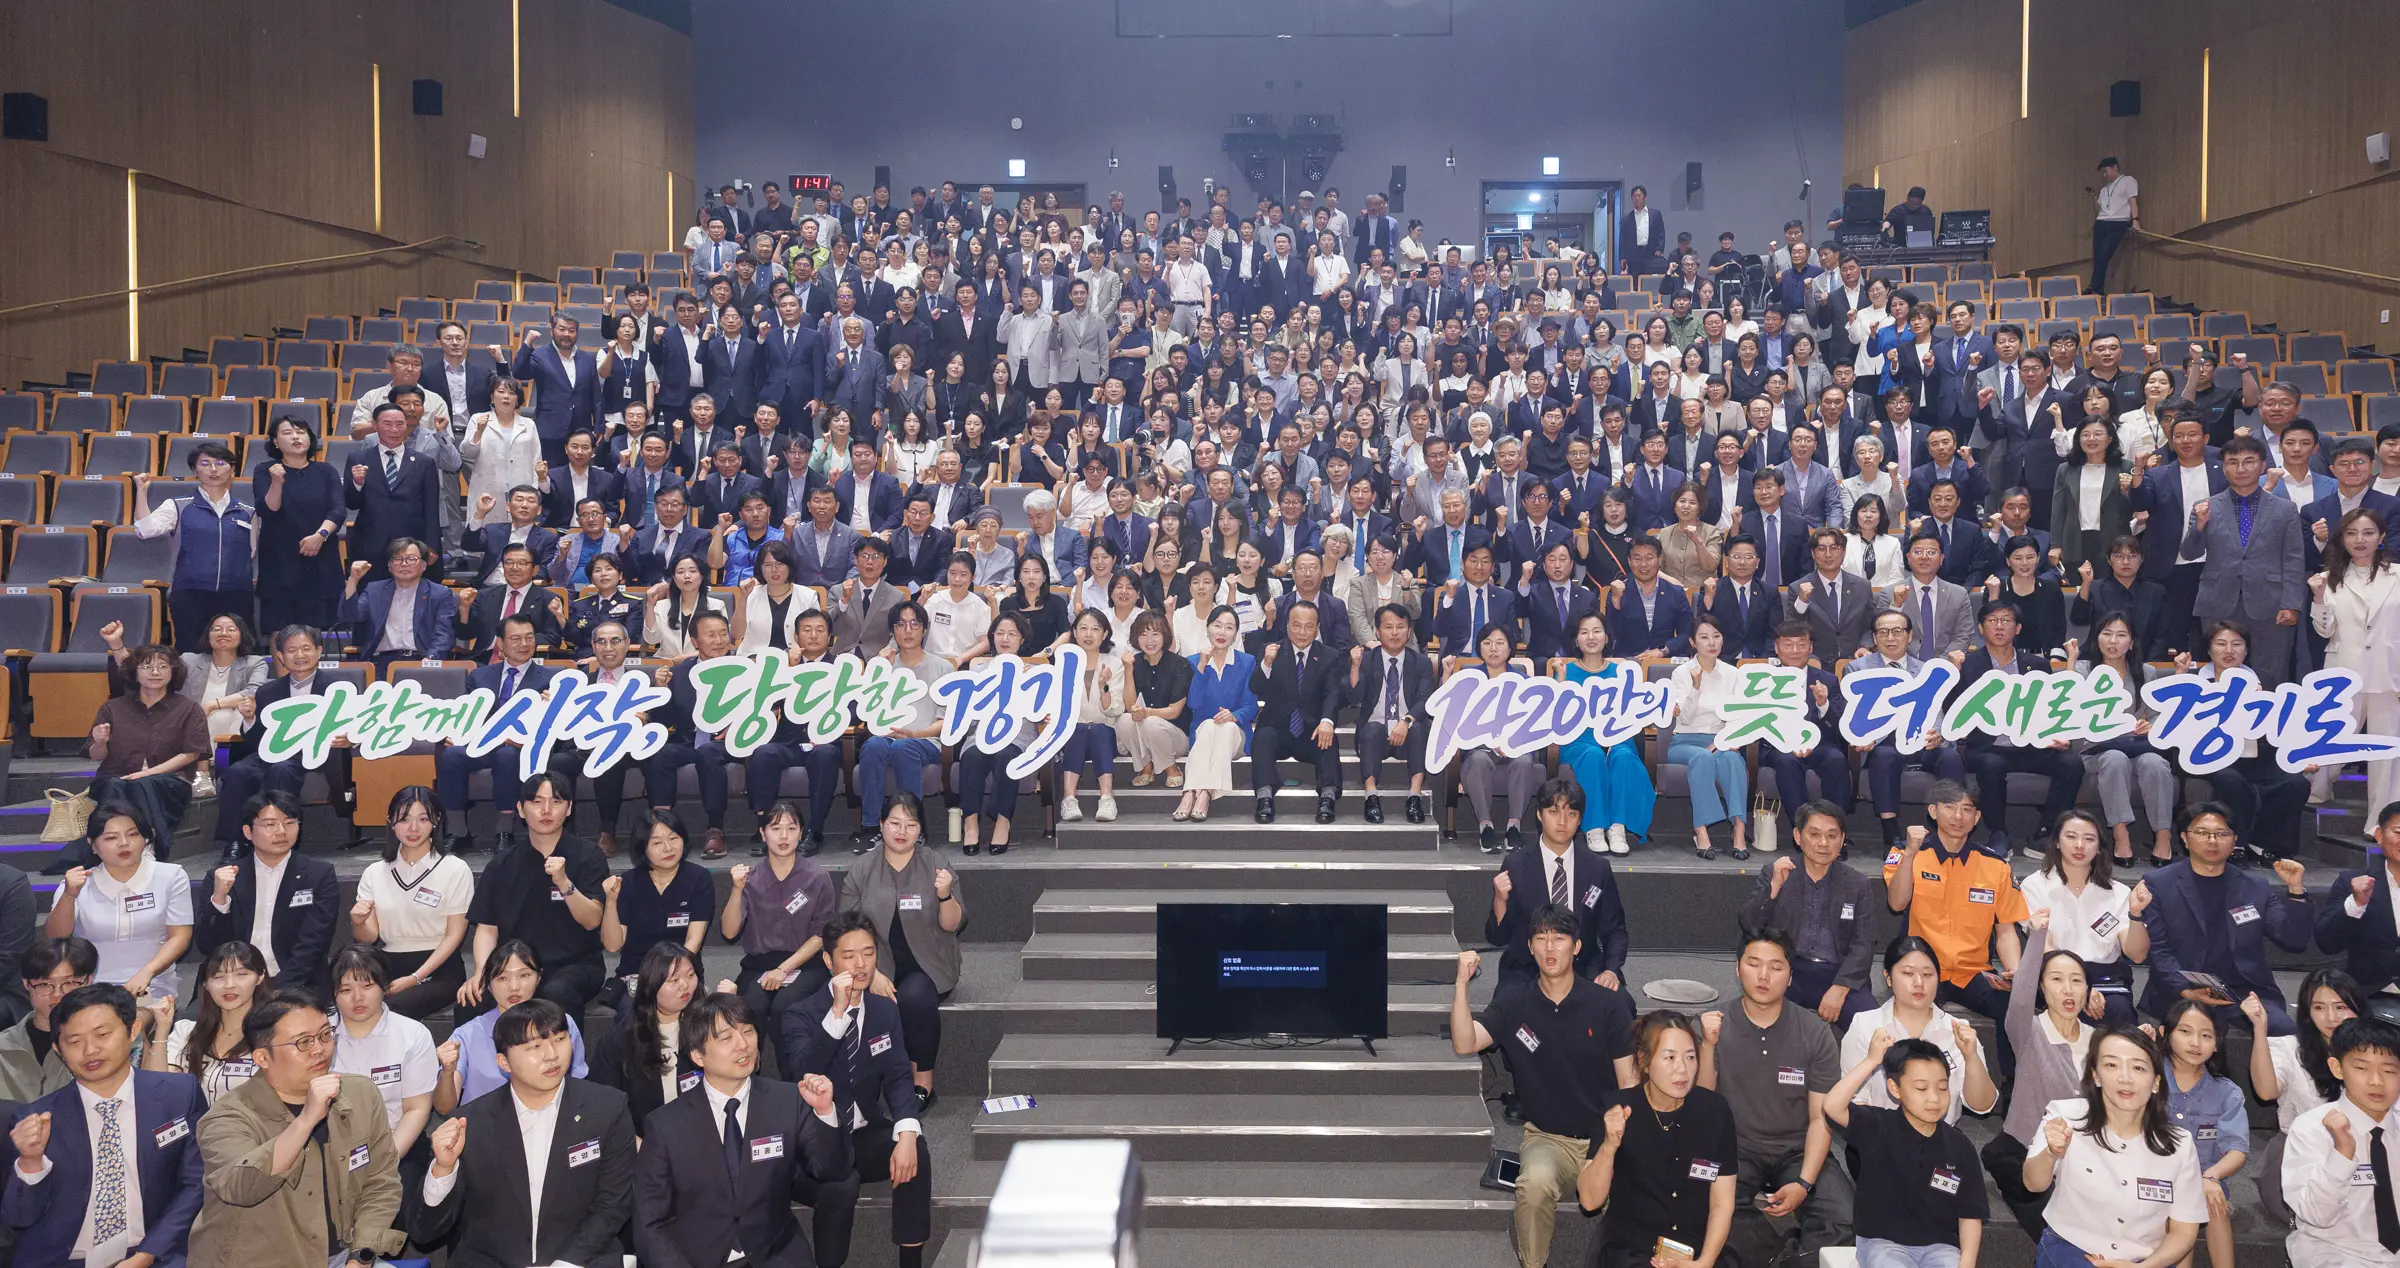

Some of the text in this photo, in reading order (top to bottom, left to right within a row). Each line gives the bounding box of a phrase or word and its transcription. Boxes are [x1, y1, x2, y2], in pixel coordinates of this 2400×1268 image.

[795, 177, 830, 189] 11:41
[268, 651, 1078, 775] 다함께 시작, 당당한 경기
[1432, 667, 2398, 765] 1420만의 뜻, 더 새로운 경기로
